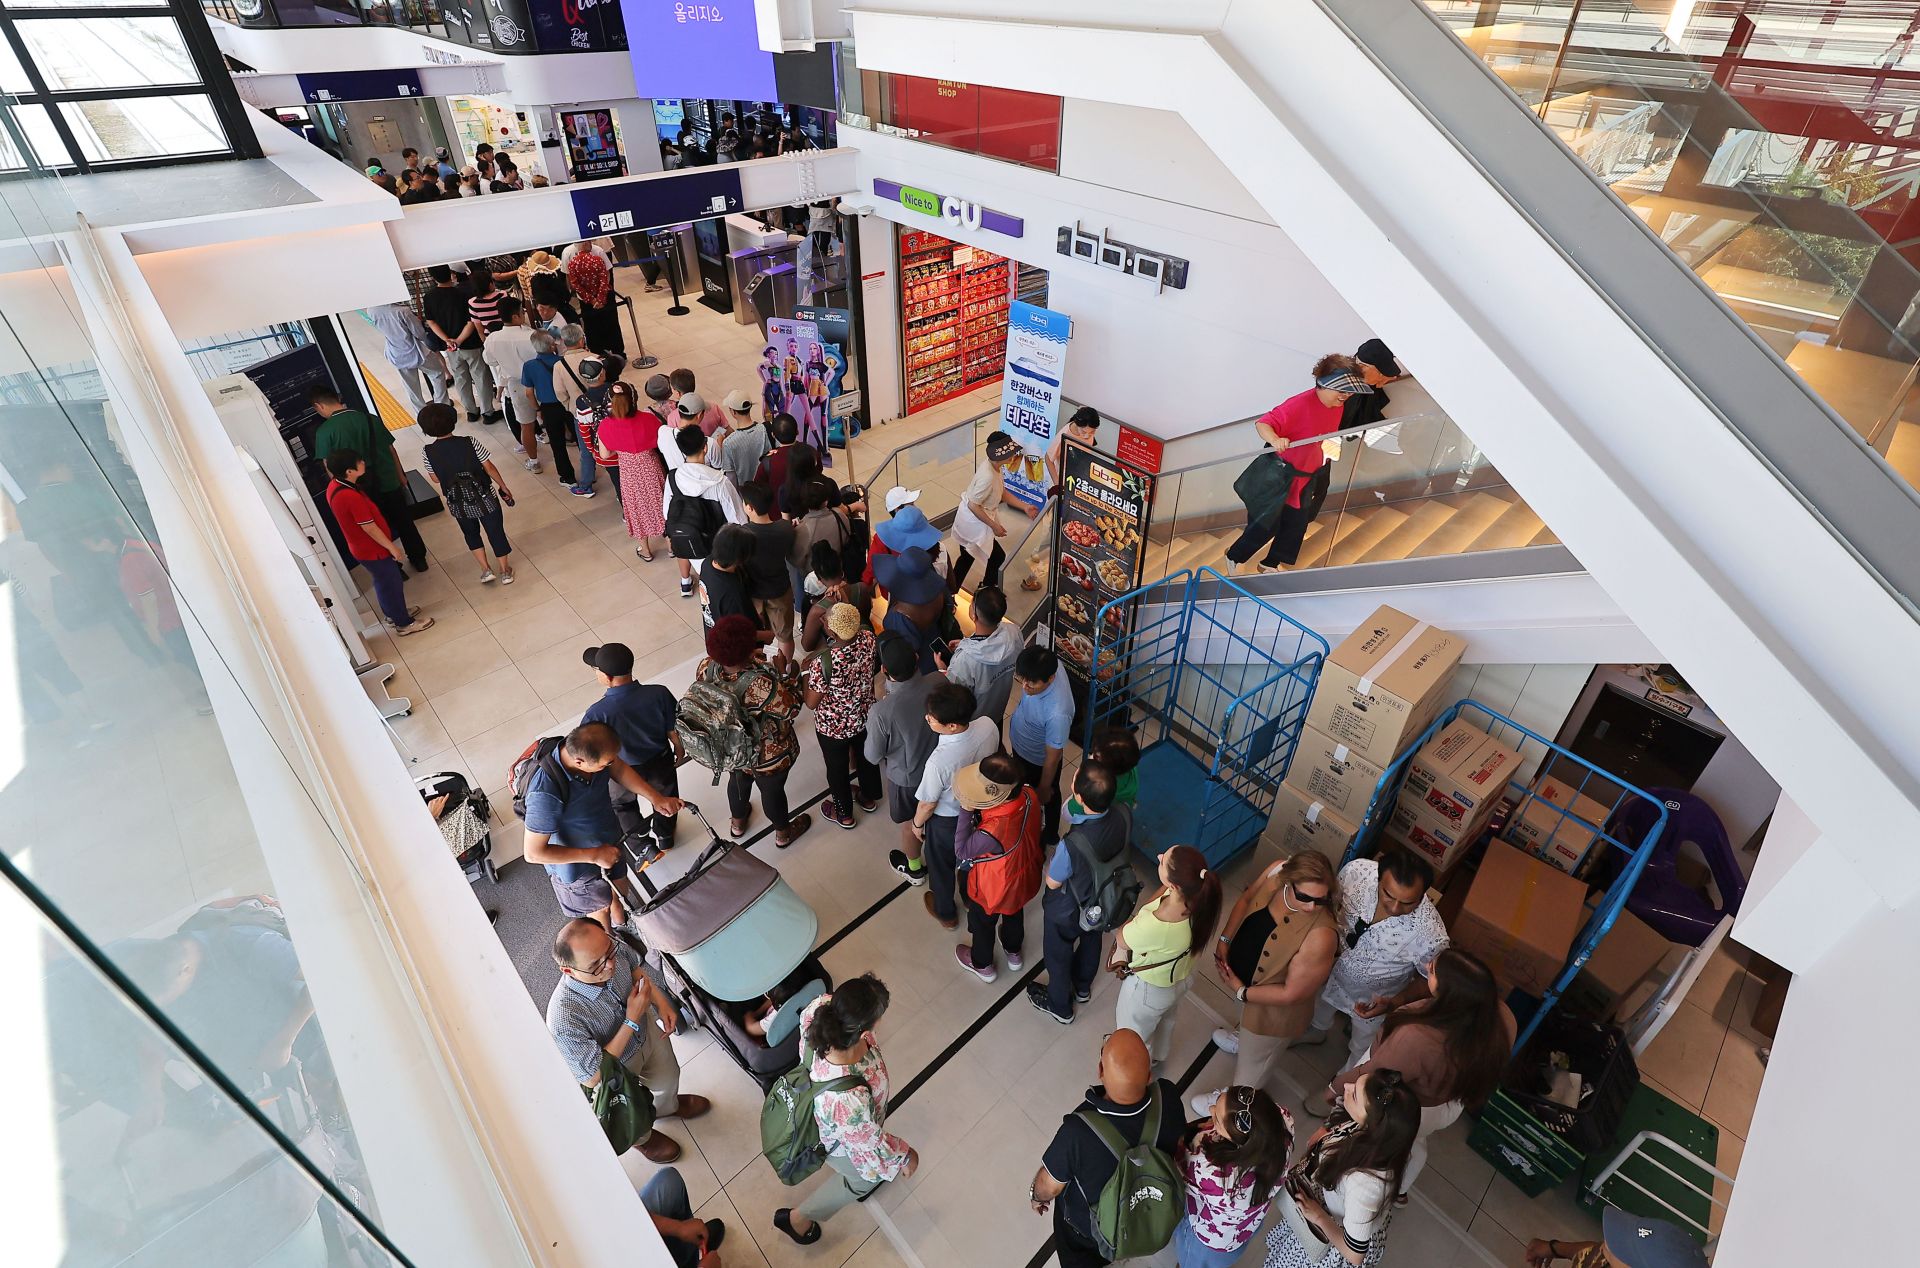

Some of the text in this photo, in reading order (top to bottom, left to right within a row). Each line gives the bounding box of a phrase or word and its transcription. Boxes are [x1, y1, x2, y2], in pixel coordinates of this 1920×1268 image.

[674, 2, 724, 23] 올리지오
[571, 27, 588, 42] Best
[571, 40, 590, 48] CHICKEN
[937, 87, 957, 98] SHOP
[601, 216, 614, 228] 2F
[904, 192, 982, 232] Nice to CU
[1010, 379, 1052, 404] 한강버스와
[1016, 394, 1045, 413] 함께하는
[1006, 404, 1050, 439] 테라生
[1075, 490, 1090, 502] Come
[1090, 496, 1098, 505] up
[1104, 504, 1113, 513] the
[1076, 478, 1099, 498] 2층으로
[1100, 490, 1138, 517] 올라오세요
